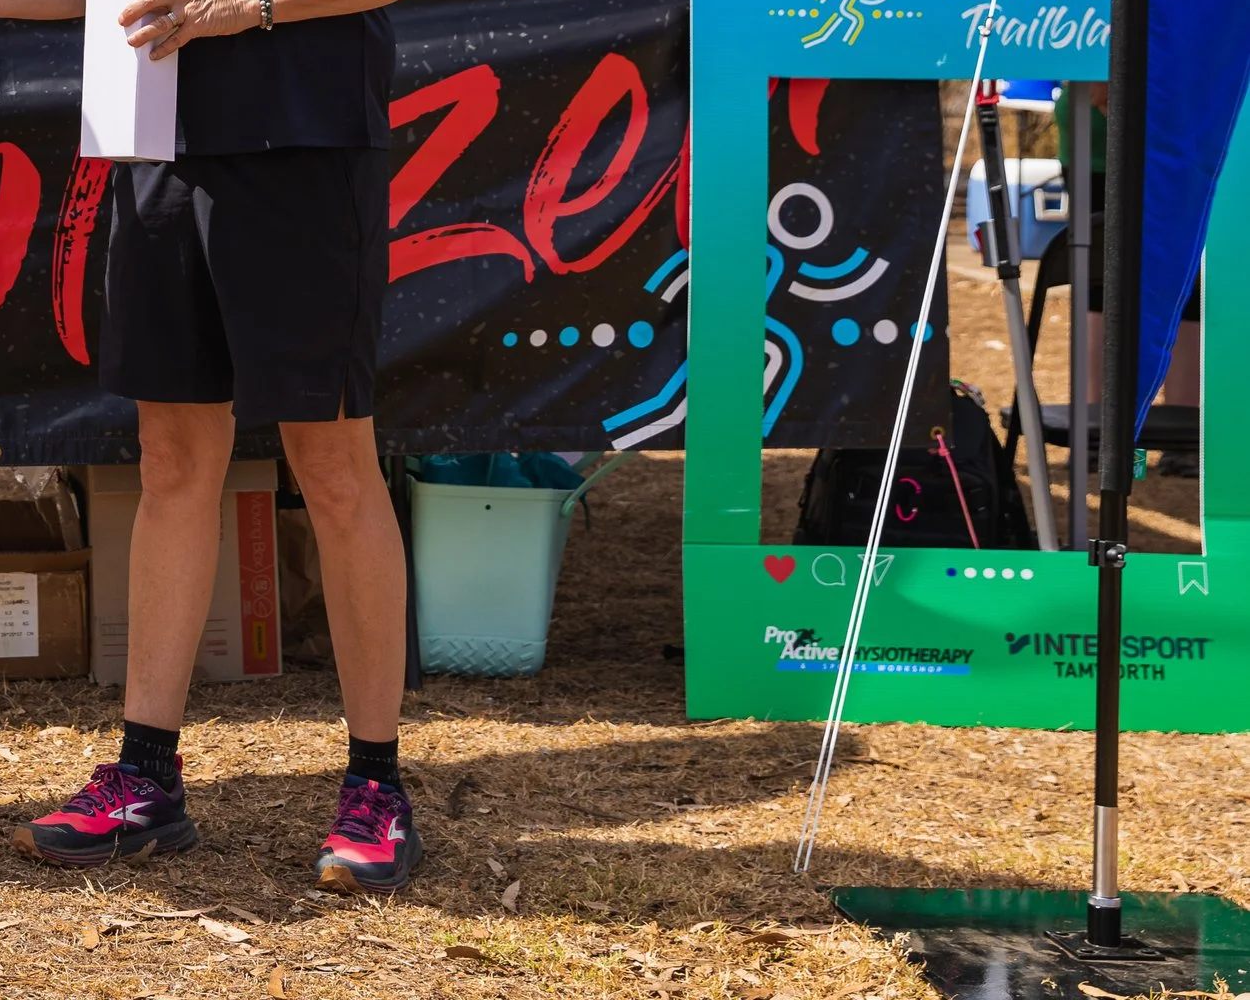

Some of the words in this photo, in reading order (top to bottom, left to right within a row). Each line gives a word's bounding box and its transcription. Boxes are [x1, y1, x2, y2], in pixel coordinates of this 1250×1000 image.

[764, 626, 797, 644] Pro
[780, 642, 839, 661] Active
[1034, 633, 1213, 660] INTESPORT
[822, 663, 867, 671] SPTS
[1054, 661, 1165, 681] TAMRTH
